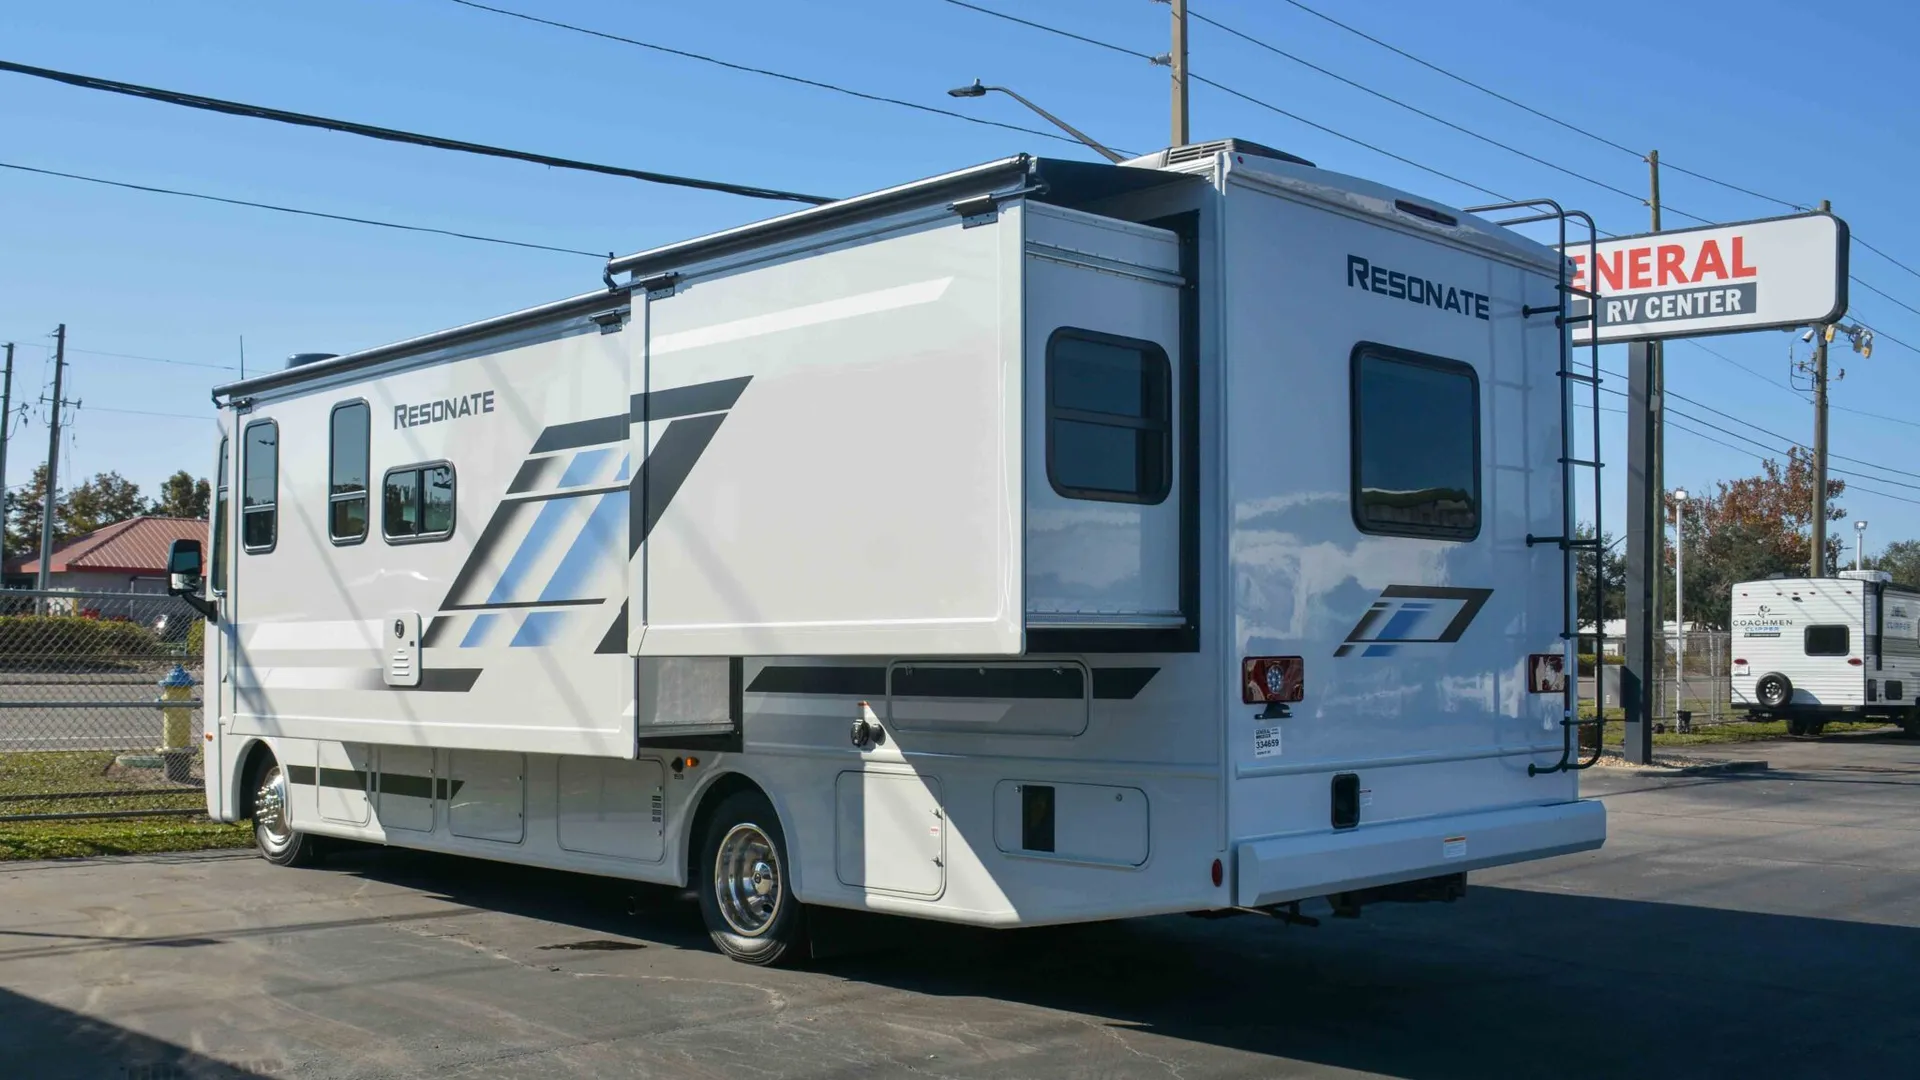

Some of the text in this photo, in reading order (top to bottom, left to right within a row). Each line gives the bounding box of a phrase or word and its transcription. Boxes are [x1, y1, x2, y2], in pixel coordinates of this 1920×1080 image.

[1571, 236, 1757, 292] ENERAL
[1347, 254, 1489, 321] RESONATE
[1607, 288, 1742, 323] RV CENTER
[394, 390, 494, 430] RESONATE
[1732, 619, 1793, 627] COACHMEN
[1256, 739, 1280, 749] 334659
